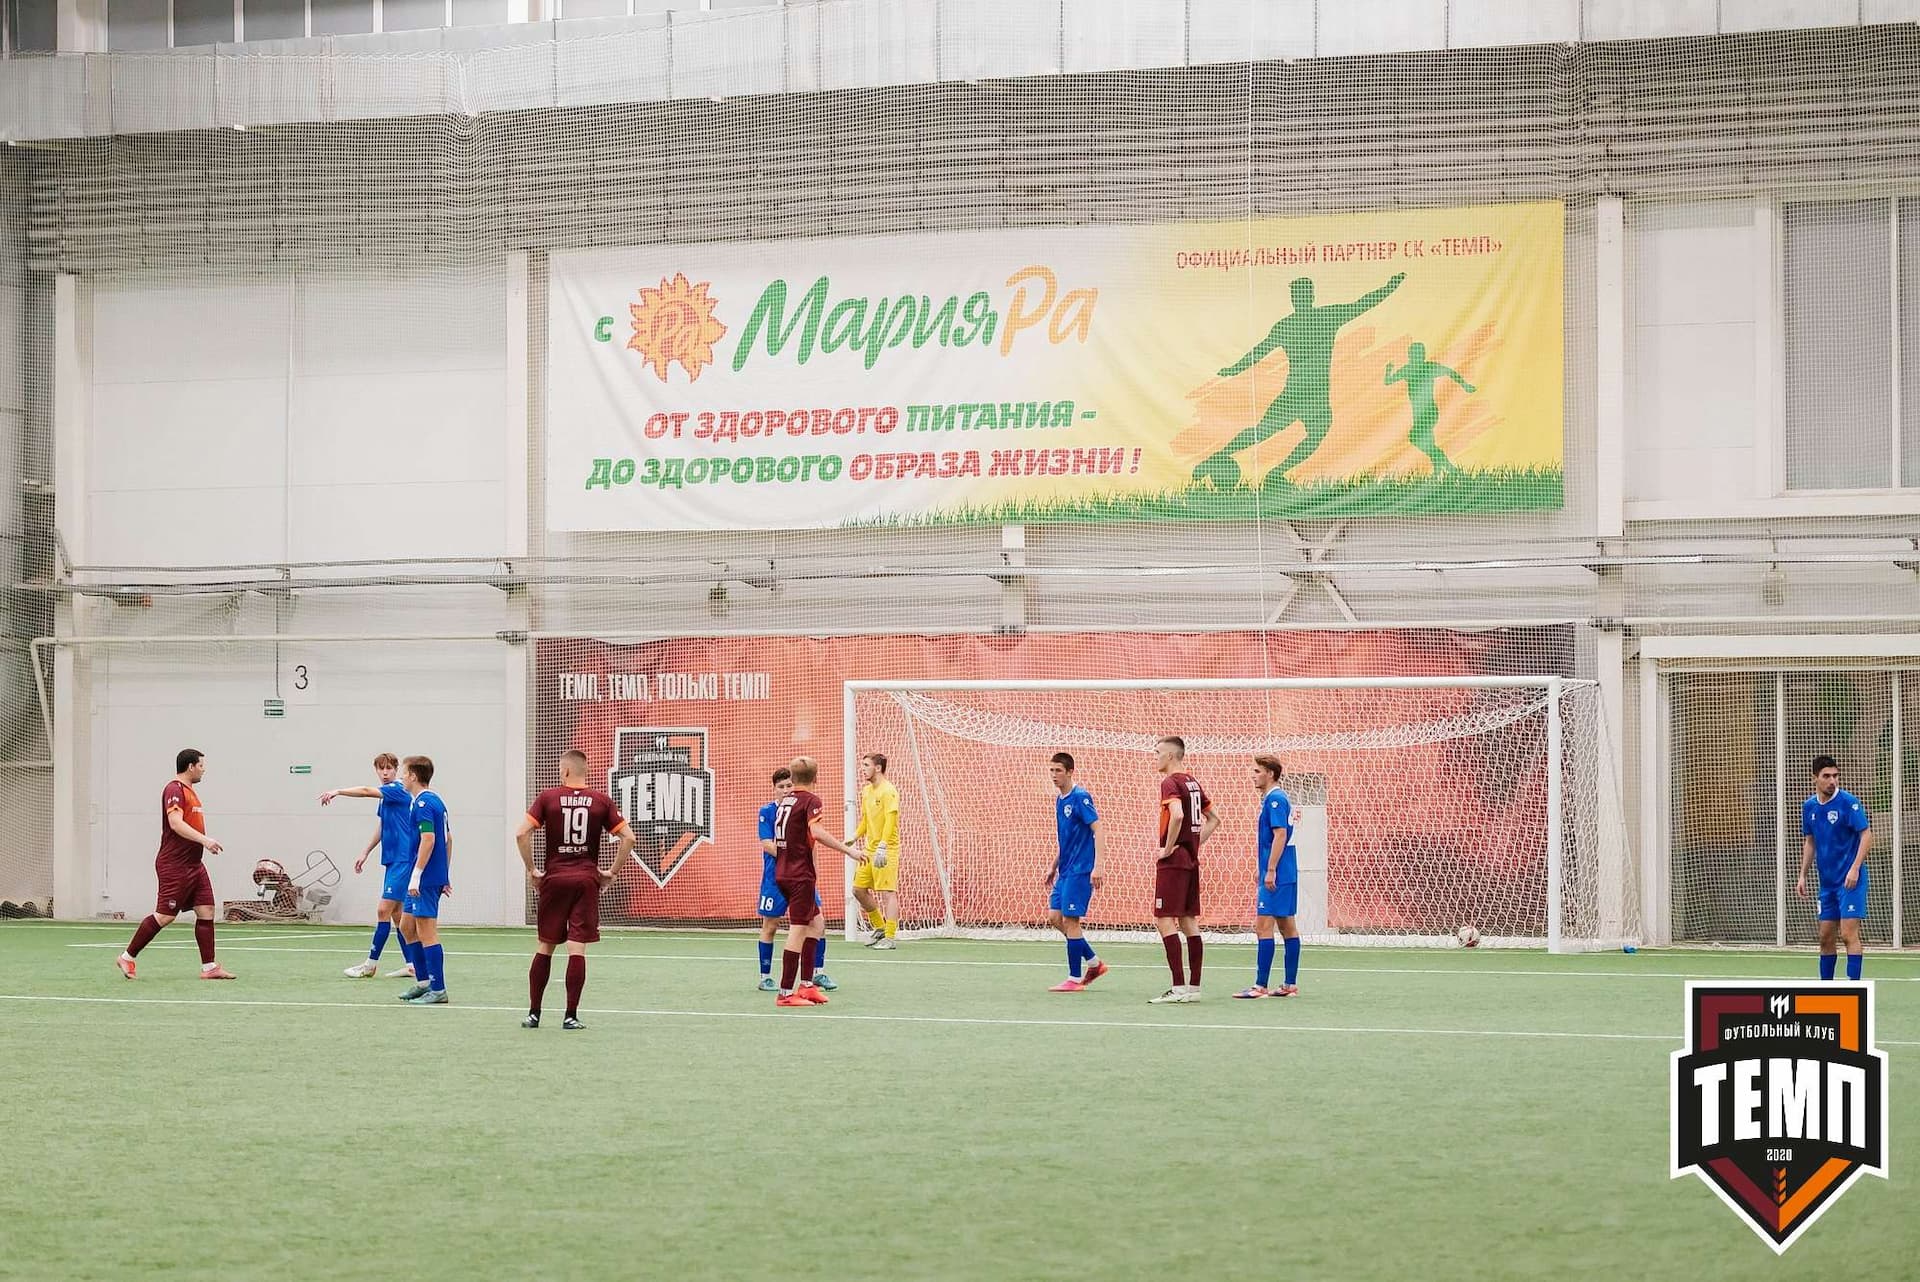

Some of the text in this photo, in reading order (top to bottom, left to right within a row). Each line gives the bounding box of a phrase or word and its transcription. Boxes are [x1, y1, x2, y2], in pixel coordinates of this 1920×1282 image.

[1176, 235, 1503, 271] ОФИЦИАЛЬНЫЙ ПАРТНЕР СК «ТЕМП»
[643, 412, 690, 440] ОТ
[694, 406, 900, 443] ЗДОРОВОГО
[906, 401, 1074, 432] ПИТАНИЯ
[585, 457, 635, 490] ДО
[640, 454, 844, 489] ЗДОРОВОГО
[848, 450, 981, 482] ОБРАЗА
[294, 664, 309, 690] 3
[559, 672, 770, 703] ТЕМП, ТЕМП, ТОЛЬКО ТЕМП!
[618, 772, 704, 827] ТЕМП
[561, 807, 589, 845] 19
